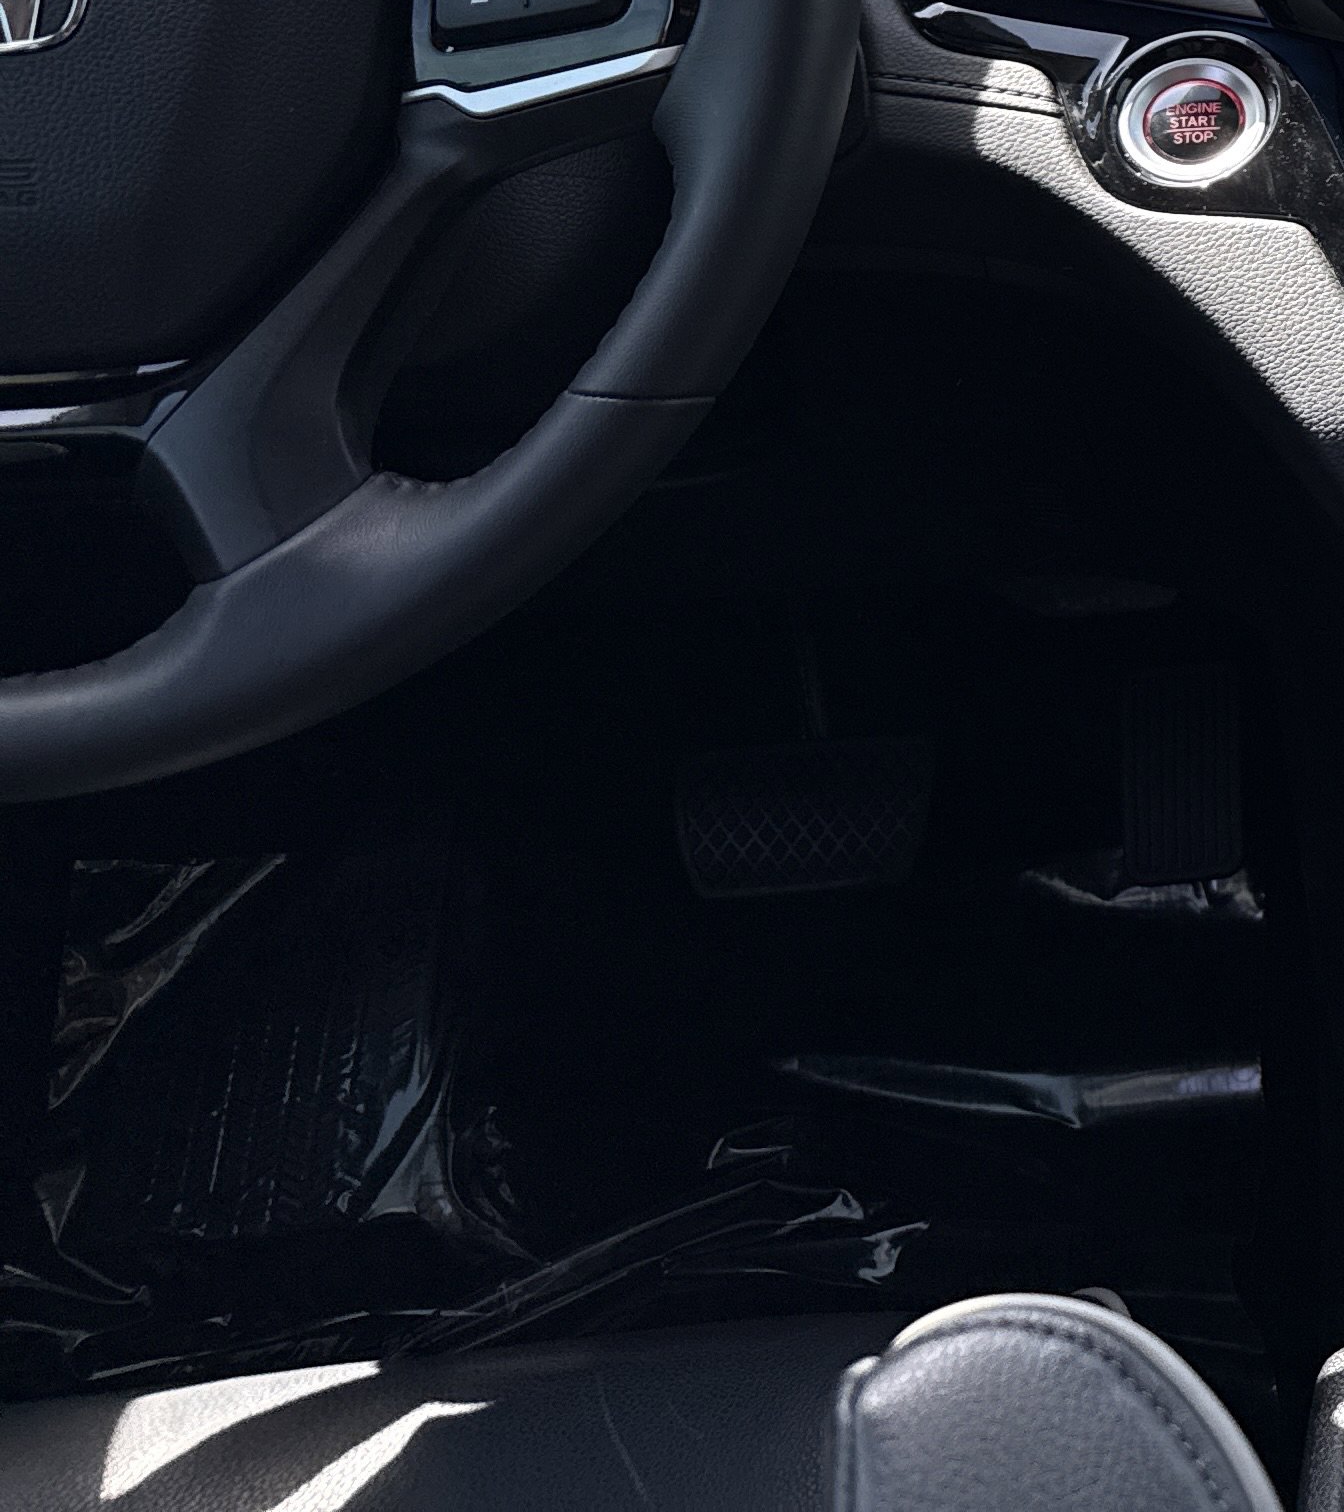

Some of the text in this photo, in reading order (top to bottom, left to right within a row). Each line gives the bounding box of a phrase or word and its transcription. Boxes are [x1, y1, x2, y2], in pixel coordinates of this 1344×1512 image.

[1166, 102, 1222, 116] ENGINE
[1170, 115, 1217, 129] START
[1173, 131, 1214, 145] STOP
